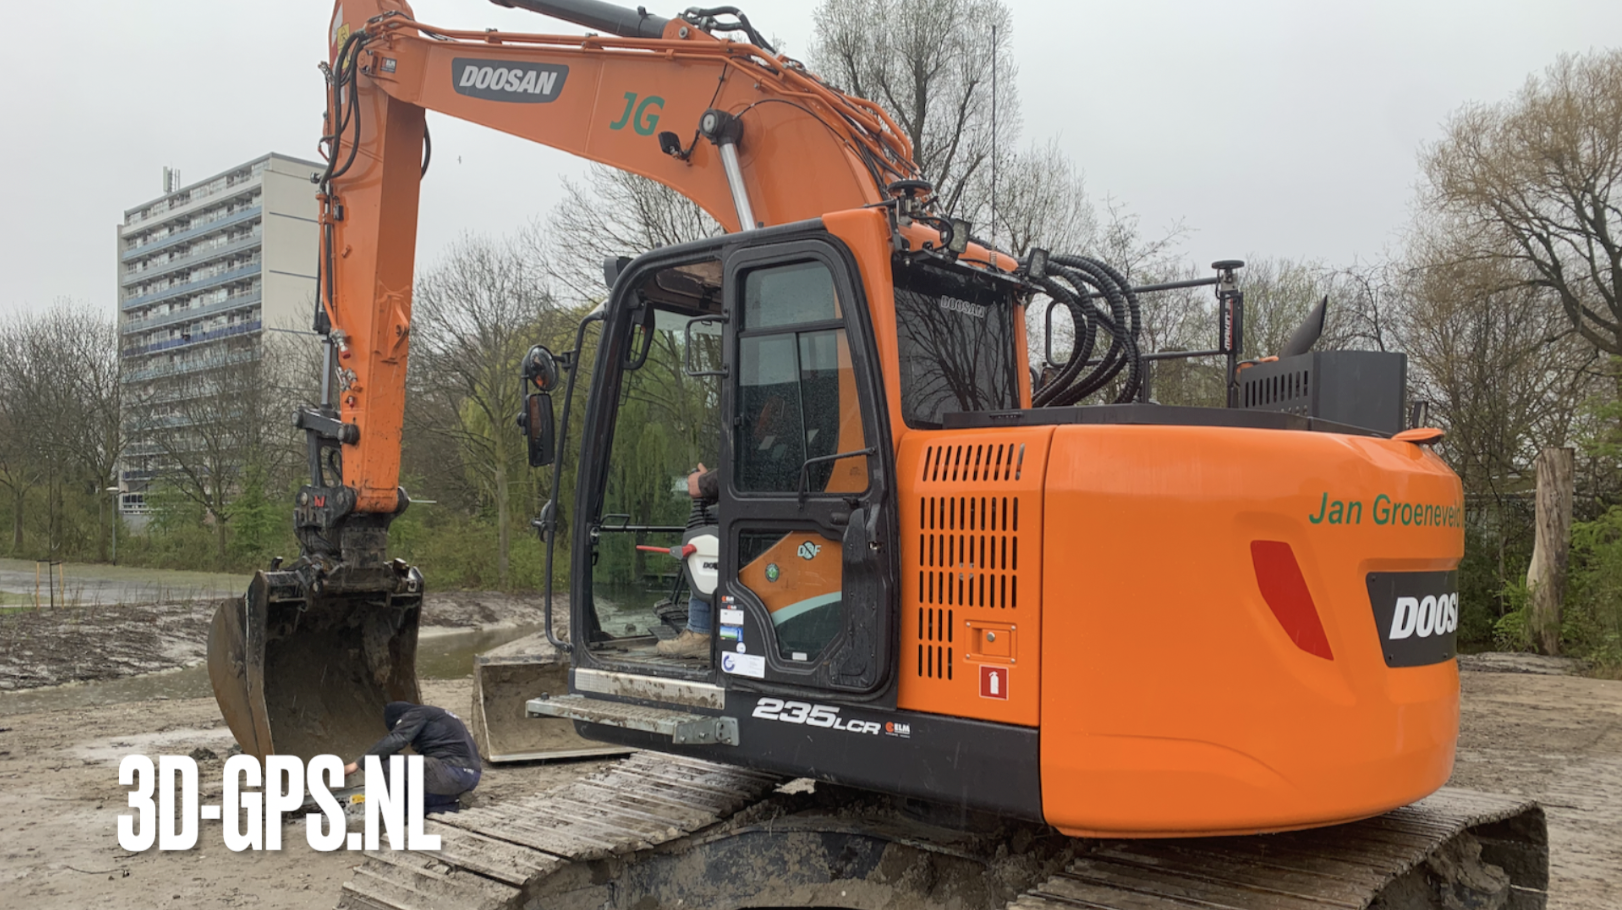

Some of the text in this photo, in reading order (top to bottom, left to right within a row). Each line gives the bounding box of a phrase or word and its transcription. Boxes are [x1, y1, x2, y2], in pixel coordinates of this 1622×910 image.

[459, 65, 558, 95] DOOSAN
[609, 91, 665, 136] JG
[940, 294, 985, 319] DOOSAN
[1308, 491, 1363, 525] Jan
